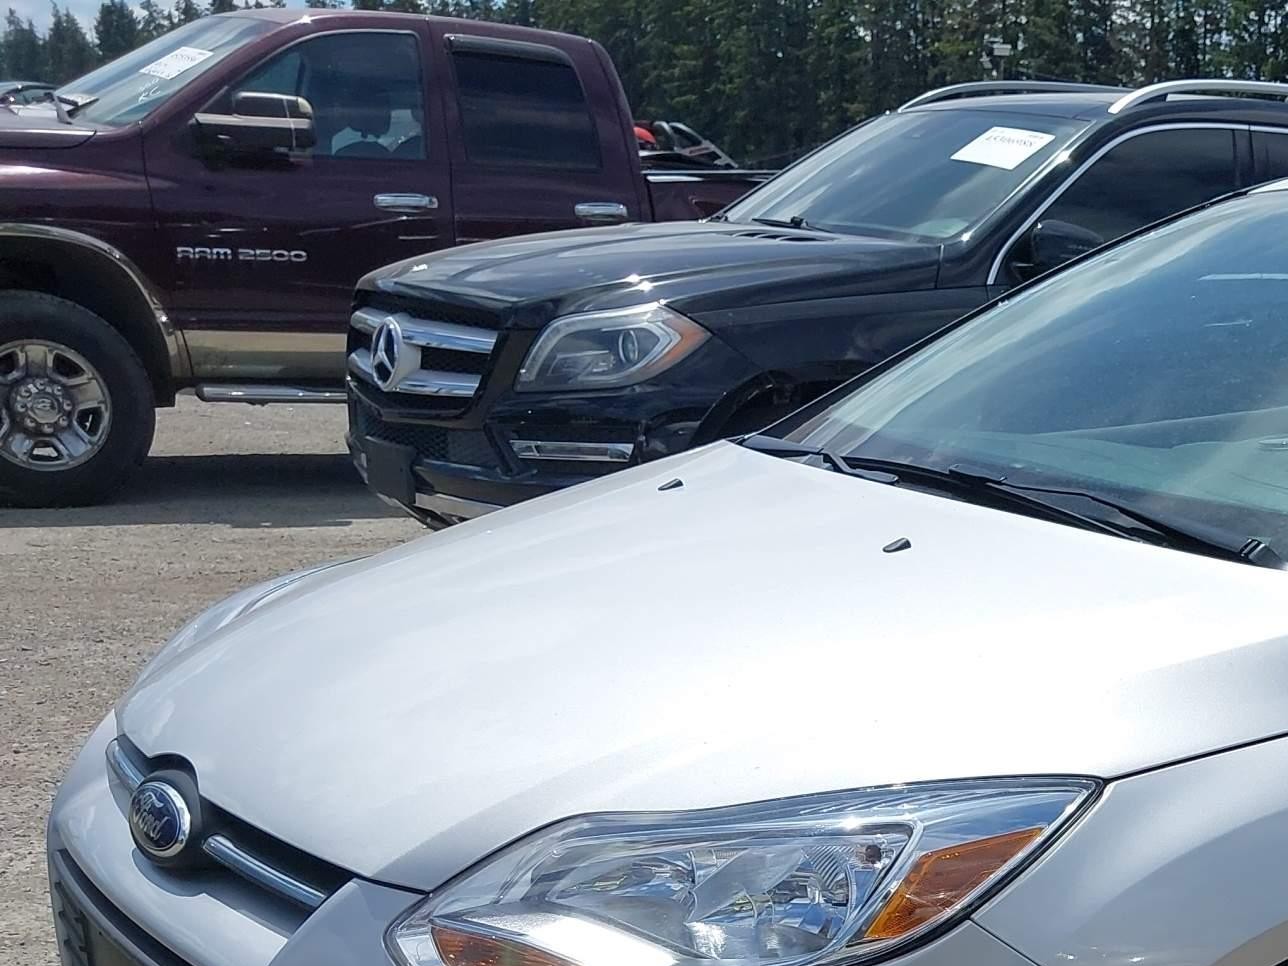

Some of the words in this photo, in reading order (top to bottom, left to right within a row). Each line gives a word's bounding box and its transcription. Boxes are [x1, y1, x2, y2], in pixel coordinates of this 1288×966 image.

[176, 246, 232, 260] RAM
[238, 249, 308, 262] 2500
[133, 792, 168, 840] Ford
